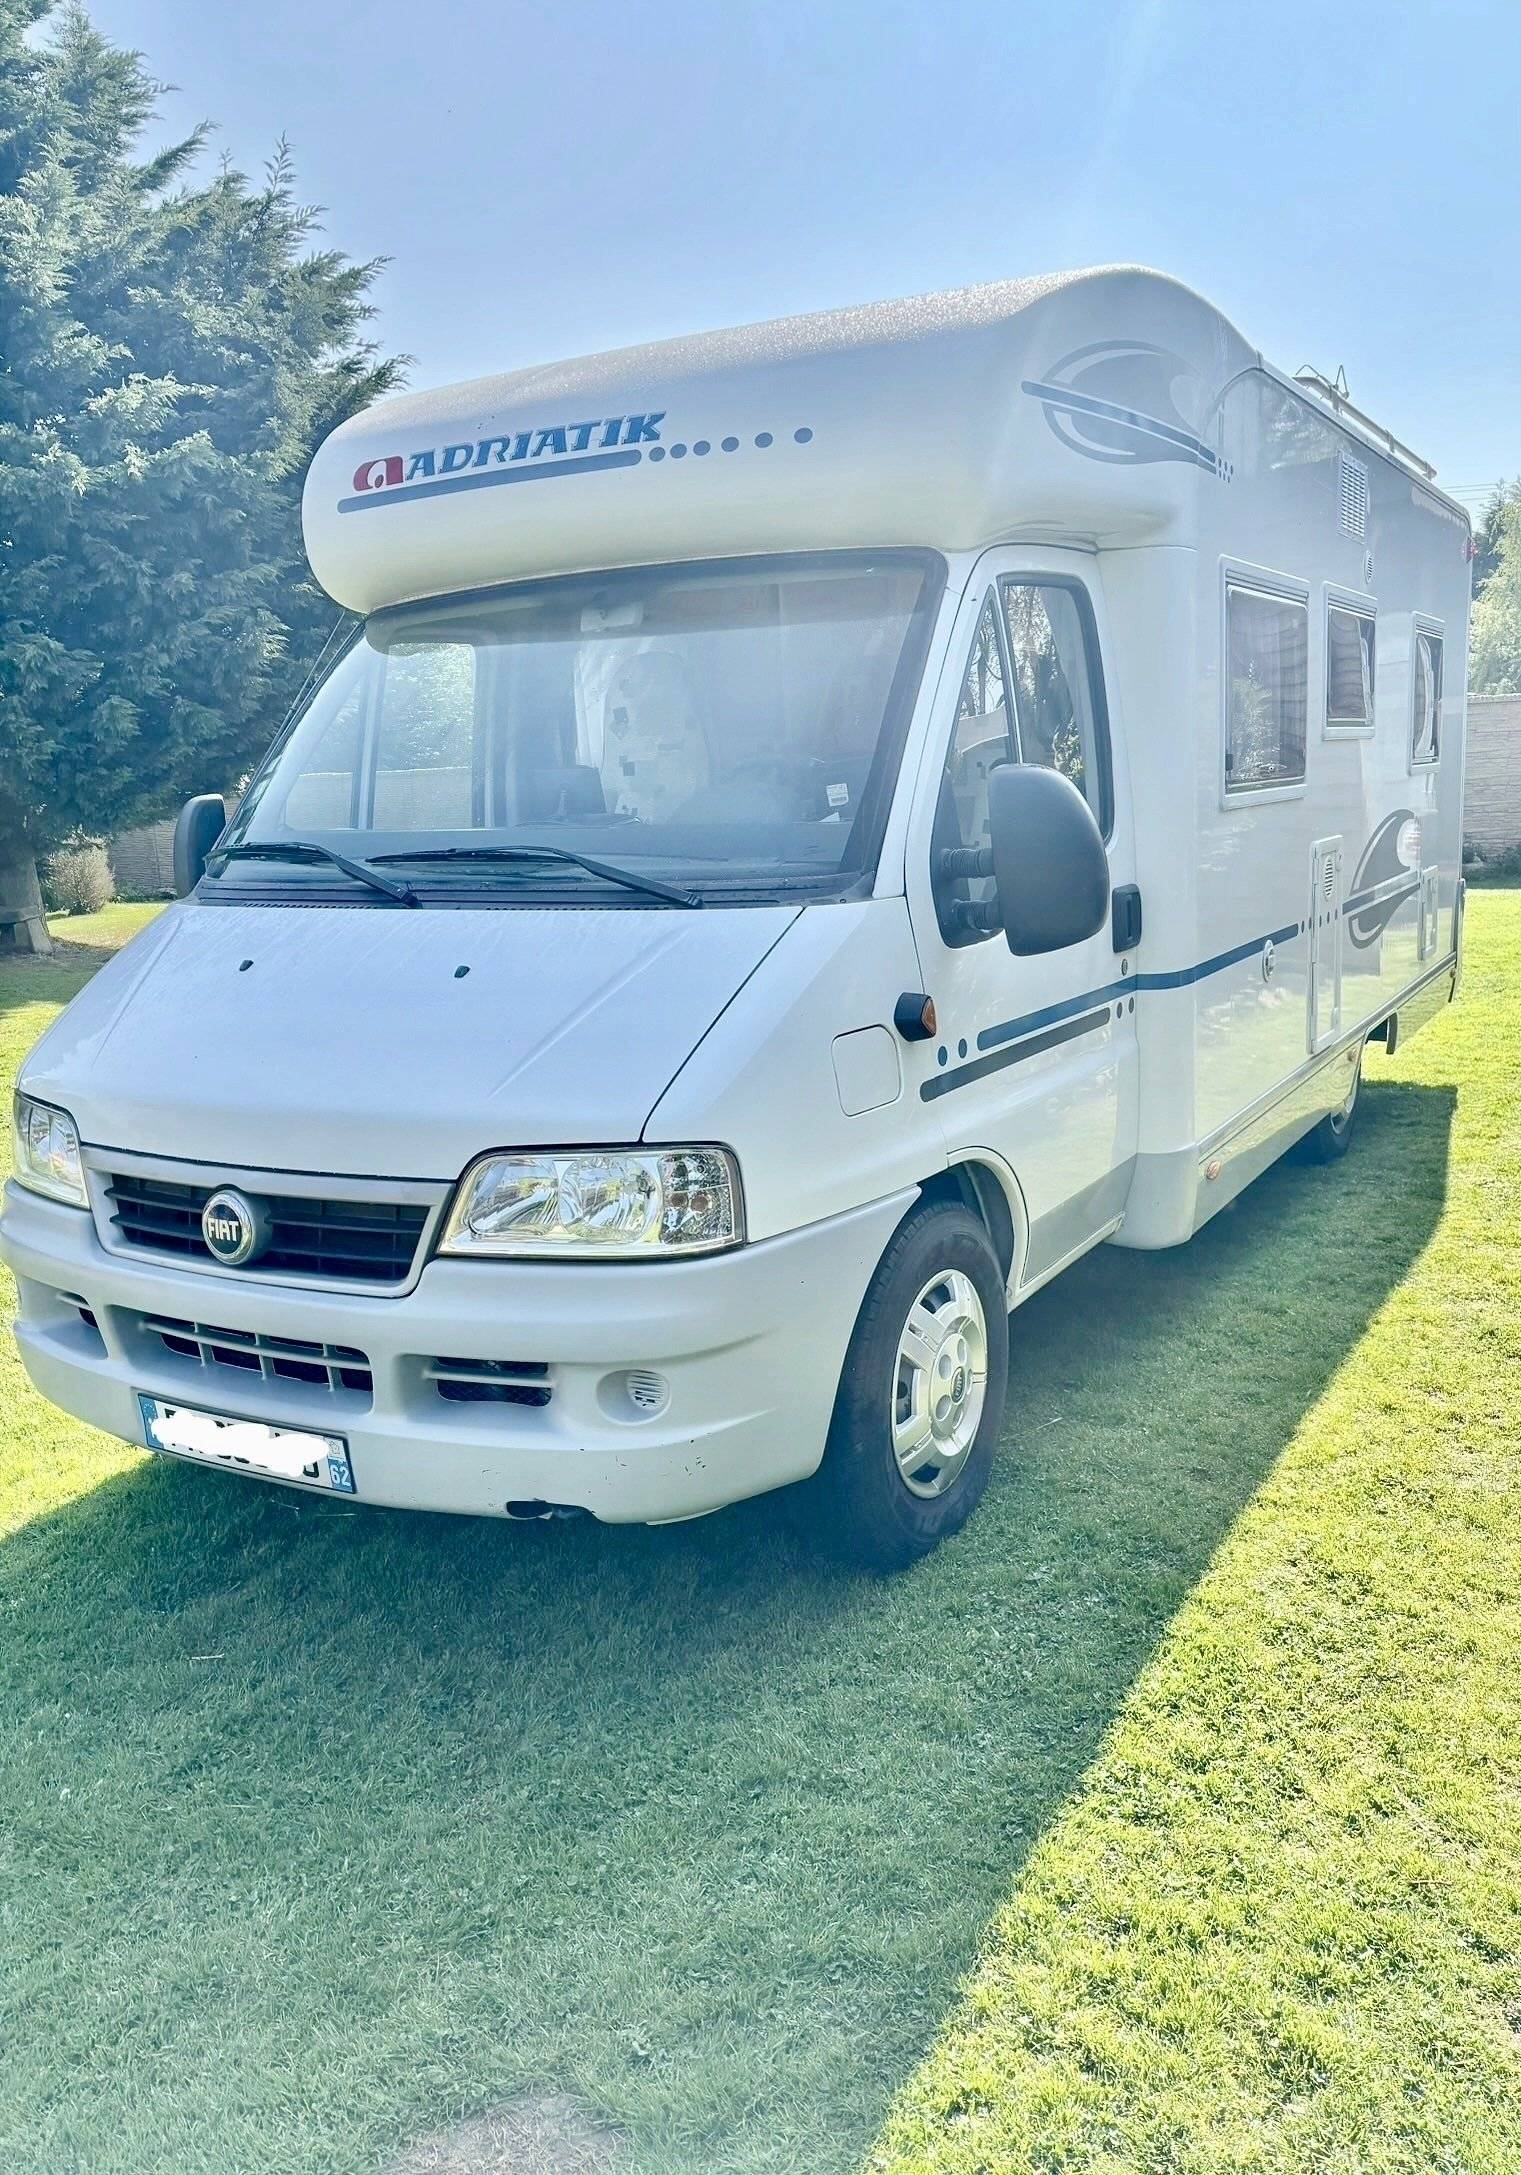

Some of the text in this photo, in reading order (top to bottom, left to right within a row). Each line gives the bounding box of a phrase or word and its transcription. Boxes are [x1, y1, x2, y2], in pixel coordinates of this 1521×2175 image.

[405, 410, 666, 481] ADRIATIK
[207, 1217, 239, 1242] FIAT
[330, 1464, 351, 1487] 62
